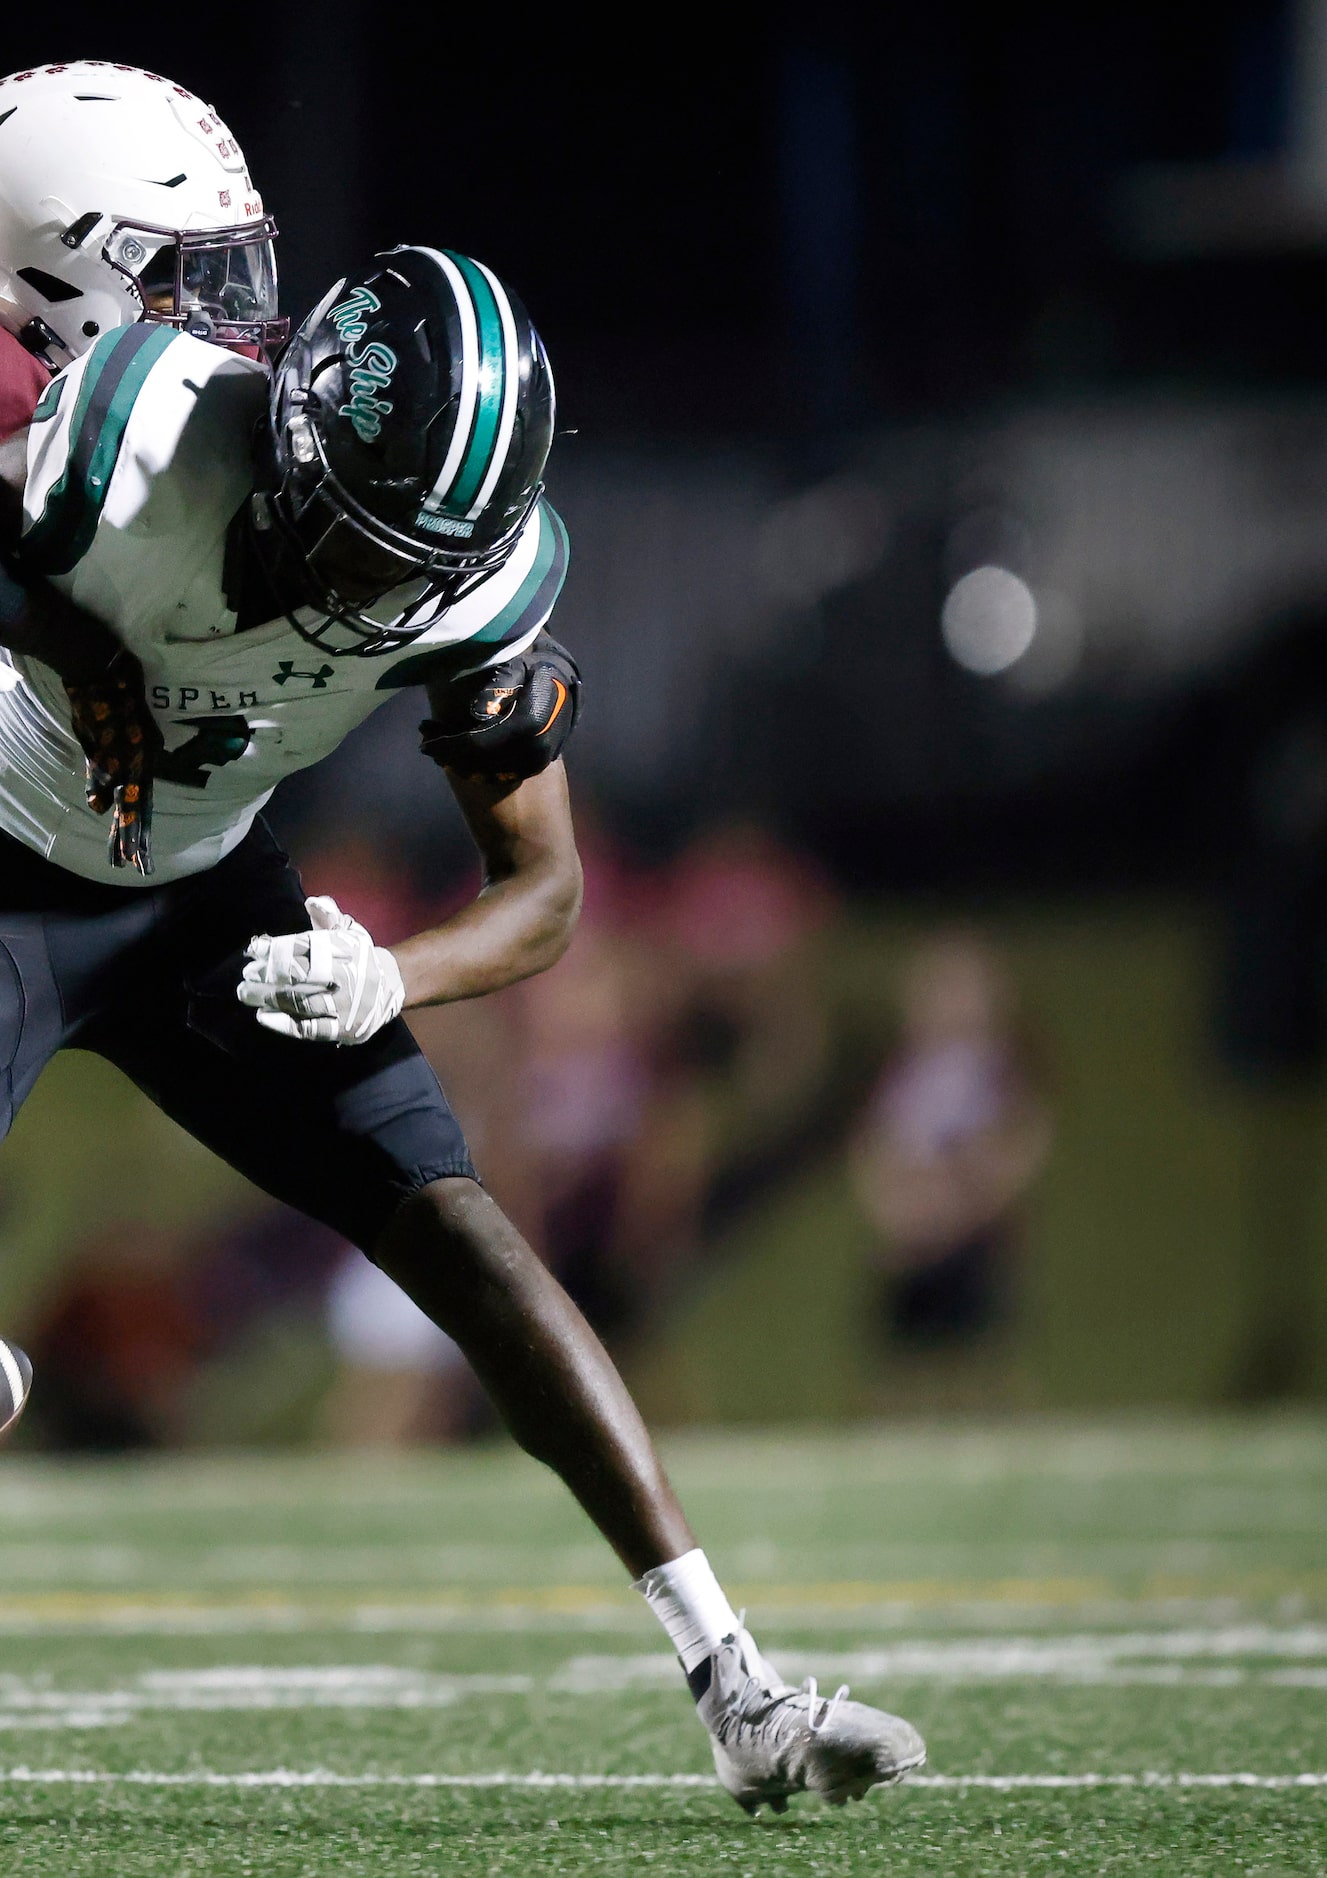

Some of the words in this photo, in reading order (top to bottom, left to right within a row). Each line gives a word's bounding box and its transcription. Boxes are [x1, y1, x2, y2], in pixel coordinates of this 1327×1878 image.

[326, 287, 381, 342] The
[338, 342, 397, 444] Ship
[414, 511, 475, 539] PROSPER
